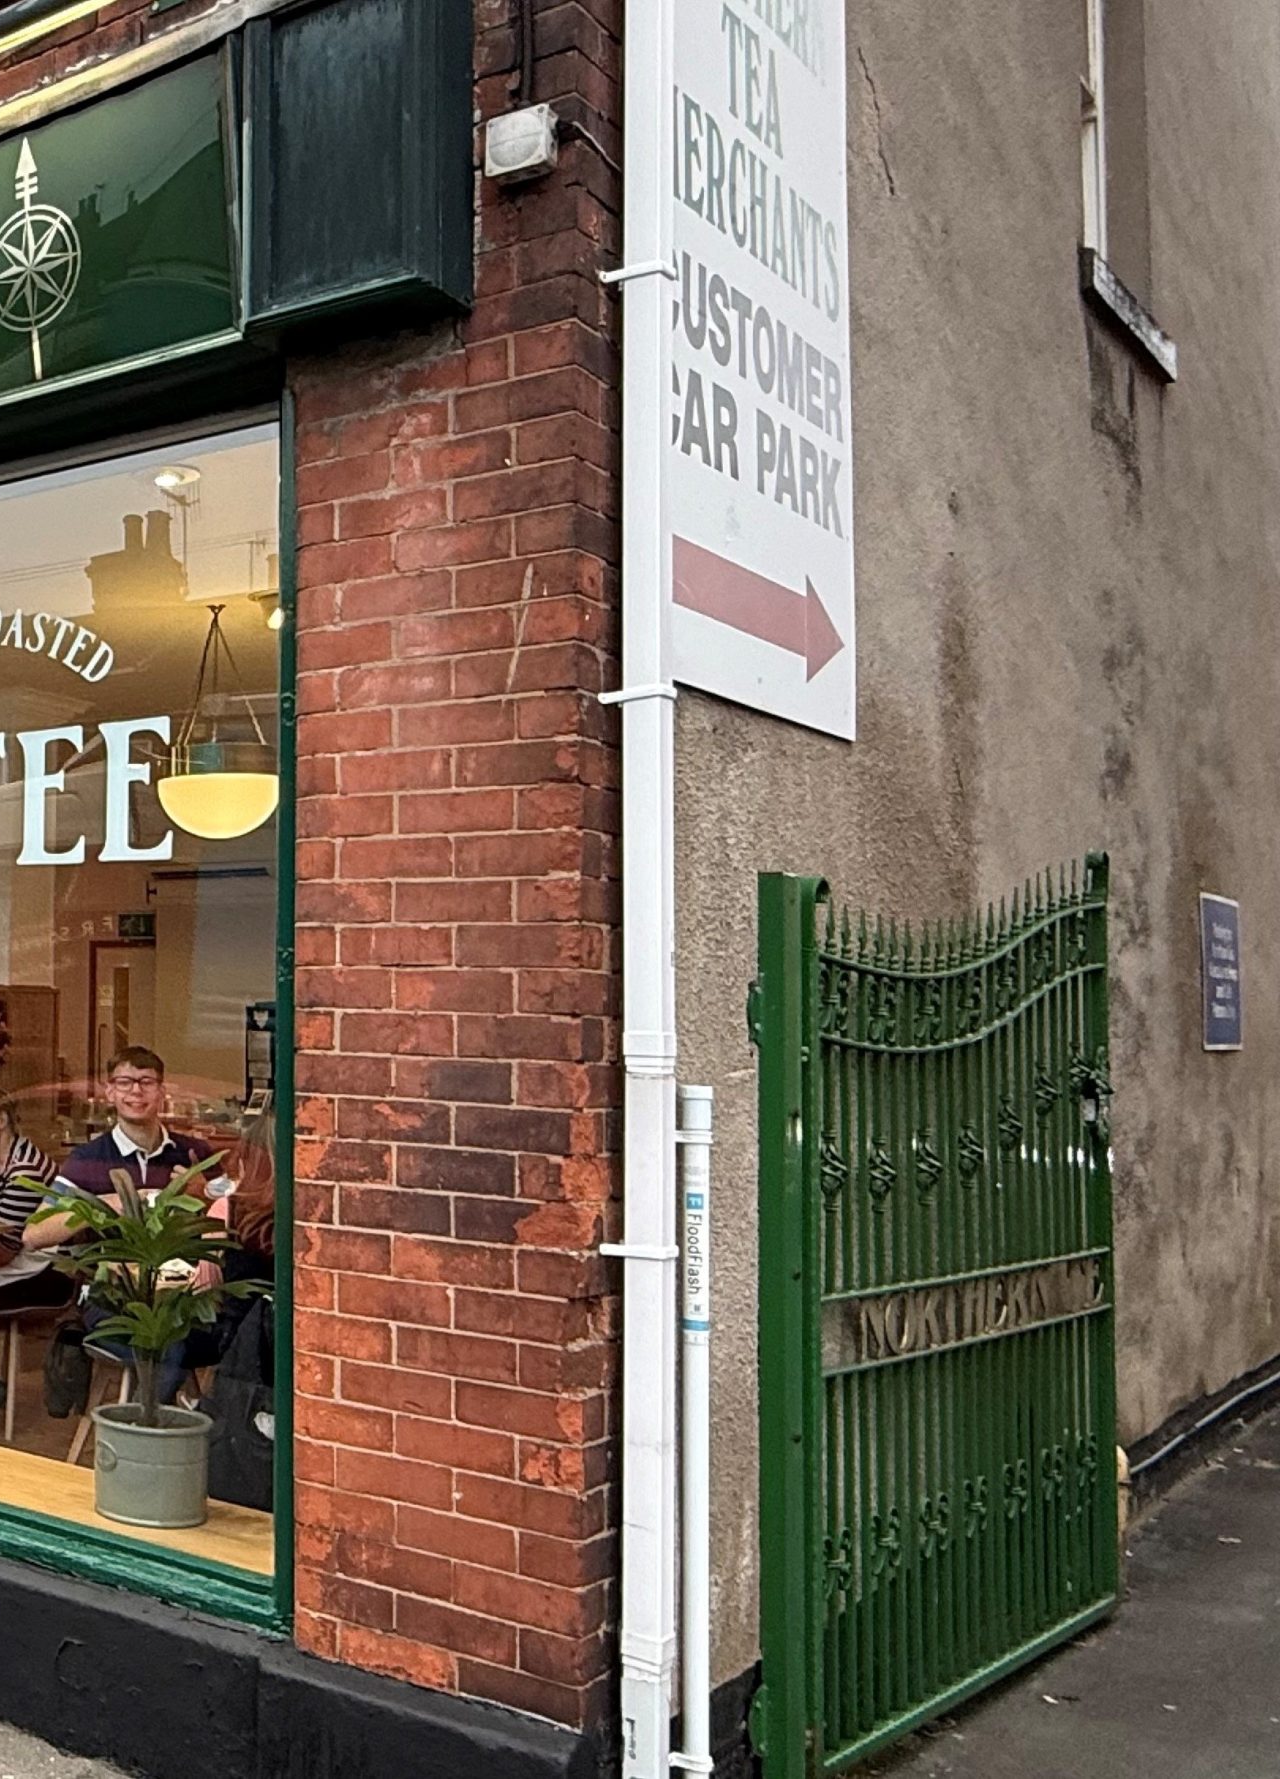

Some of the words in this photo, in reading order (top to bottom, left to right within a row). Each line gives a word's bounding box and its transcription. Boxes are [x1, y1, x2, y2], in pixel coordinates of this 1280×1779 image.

[721, 3, 784, 160] TEA
[672, 249, 844, 444] USTOMER
[672, 360, 740, 482] AR
[756, 407, 845, 540] PARK
[688, 1213, 703, 1295] FloodFlash
